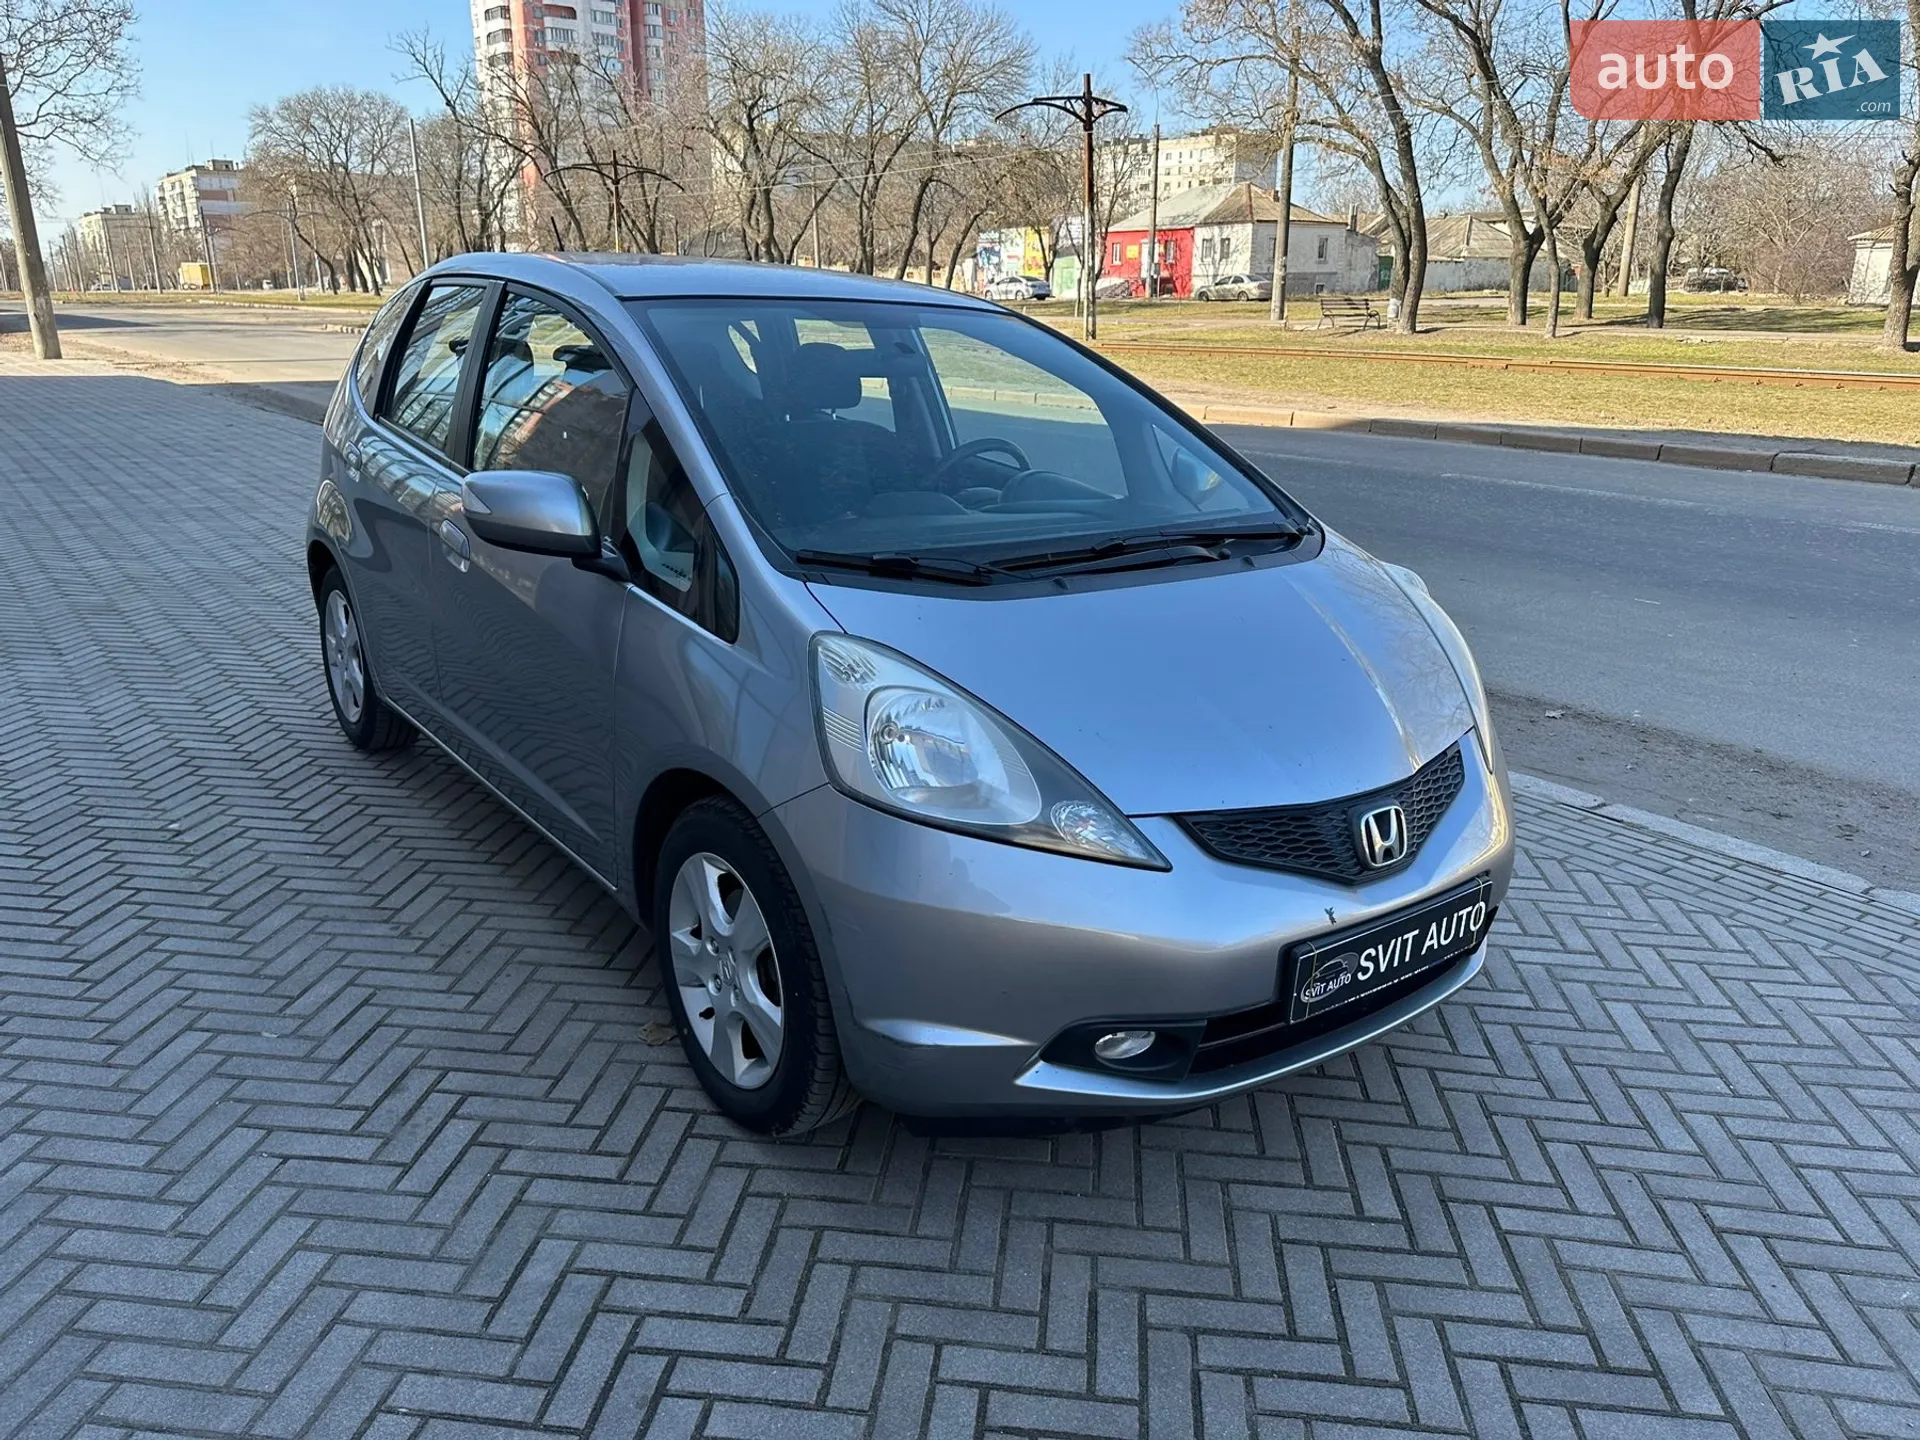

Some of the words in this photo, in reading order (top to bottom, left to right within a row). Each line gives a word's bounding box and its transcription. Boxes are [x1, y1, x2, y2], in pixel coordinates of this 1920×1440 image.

[1357, 929, 1419, 981] SVIT
[1421, 901, 1486, 956] AUTO
[1304, 982, 1326, 1000] SVIT
[1326, 972, 1351, 991] AUTO
